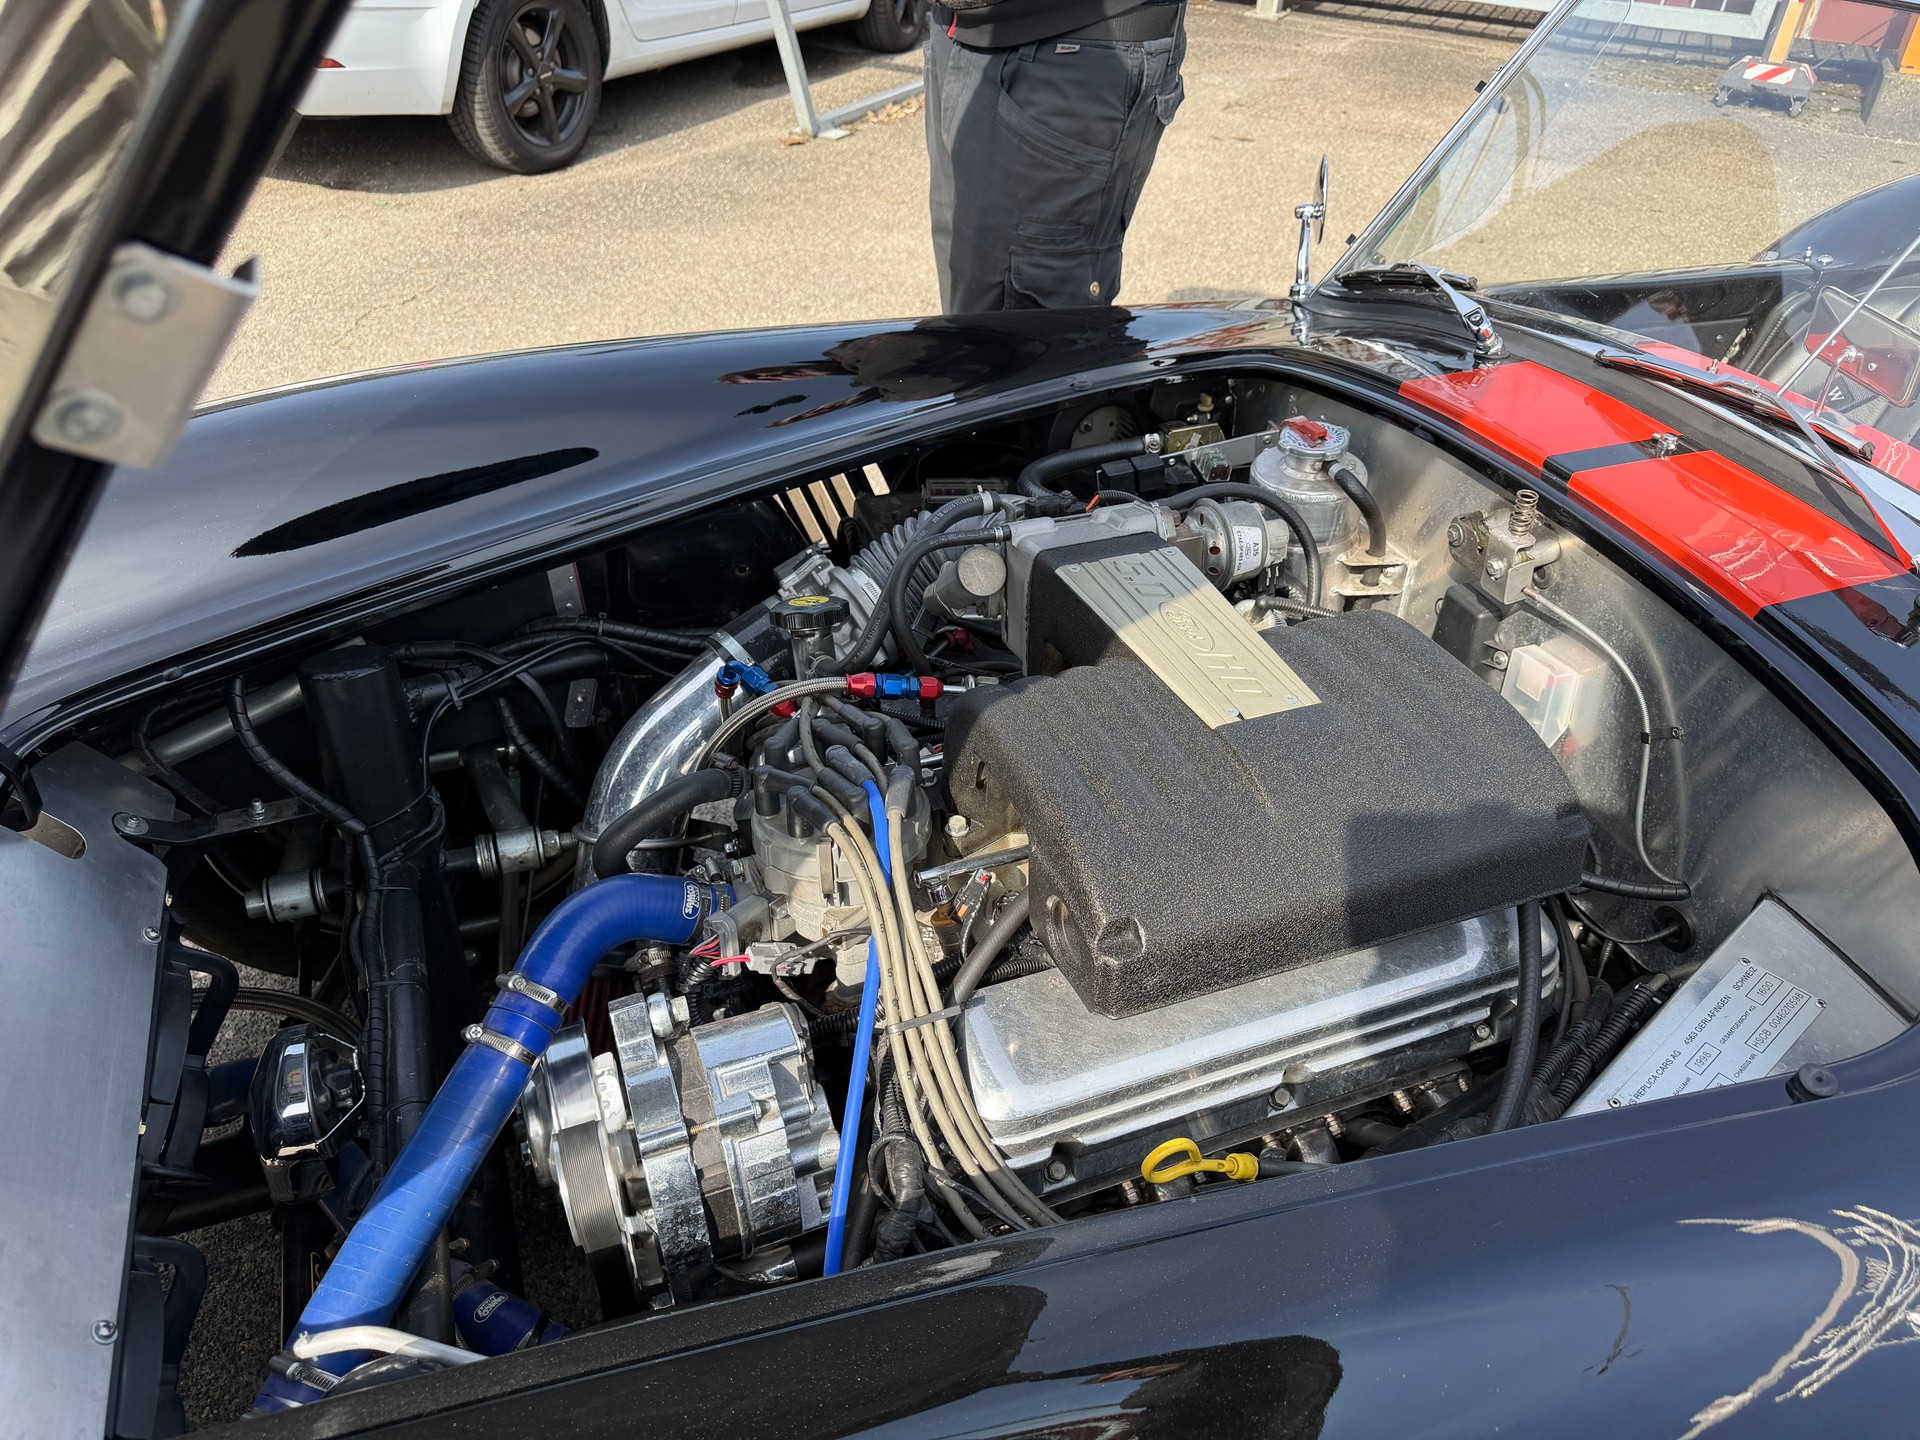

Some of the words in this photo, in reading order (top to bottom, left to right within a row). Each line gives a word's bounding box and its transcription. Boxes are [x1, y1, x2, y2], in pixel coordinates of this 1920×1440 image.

[1108, 560, 1175, 598] 5.0
[1195, 652, 1272, 697] HO
[685, 884, 696, 914] SAMCO
[1633, 1074, 1659, 1100] REPLICA
[1655, 1058, 1674, 1076] CARS
[1670, 1049, 1681, 1061] AG
[1683, 1031, 1698, 1045] 4563
[1694, 994, 1732, 1033] GERLAFINGEN
[1732, 966, 1758, 991] SCHWEIZ
[1672, 1076, 1693, 1096] BAUJAHR
[1694, 1051, 1712, 1068] 1998
[1719, 1010, 1752, 1045] GESAMTGEWICHT
[1756, 981, 1774, 997] 1600
[1733, 1059, 1753, 1079] CHASSIS
[1751, 1029, 1772, 1049] HSCB
[1768, 992, 1804, 1029] 0046270598
